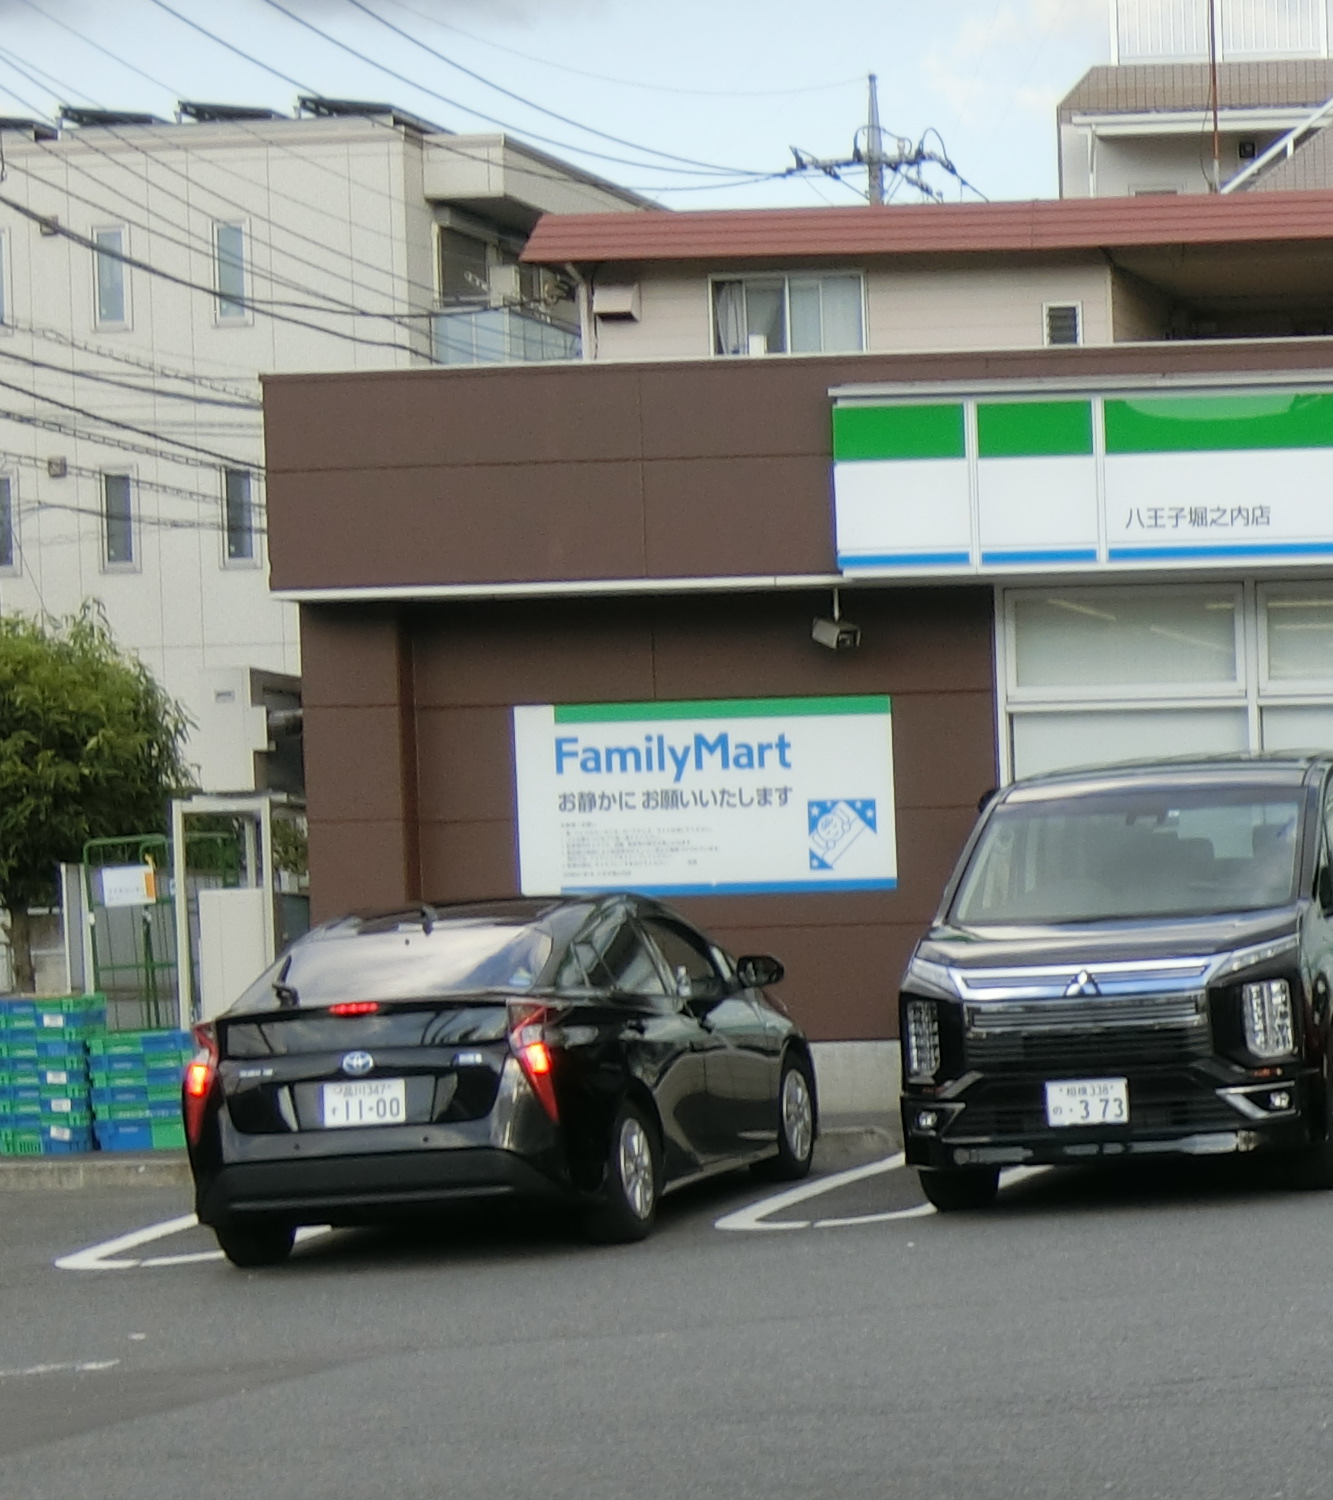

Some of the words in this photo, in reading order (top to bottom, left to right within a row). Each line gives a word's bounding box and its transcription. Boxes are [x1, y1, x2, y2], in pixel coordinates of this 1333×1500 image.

[1125, 504, 1271, 529] 八王子堀之内店
[554, 732, 793, 783] FamilyMart
[558, 791, 637, 814] お静かに
[642, 786, 794, 811] お願いいたします
